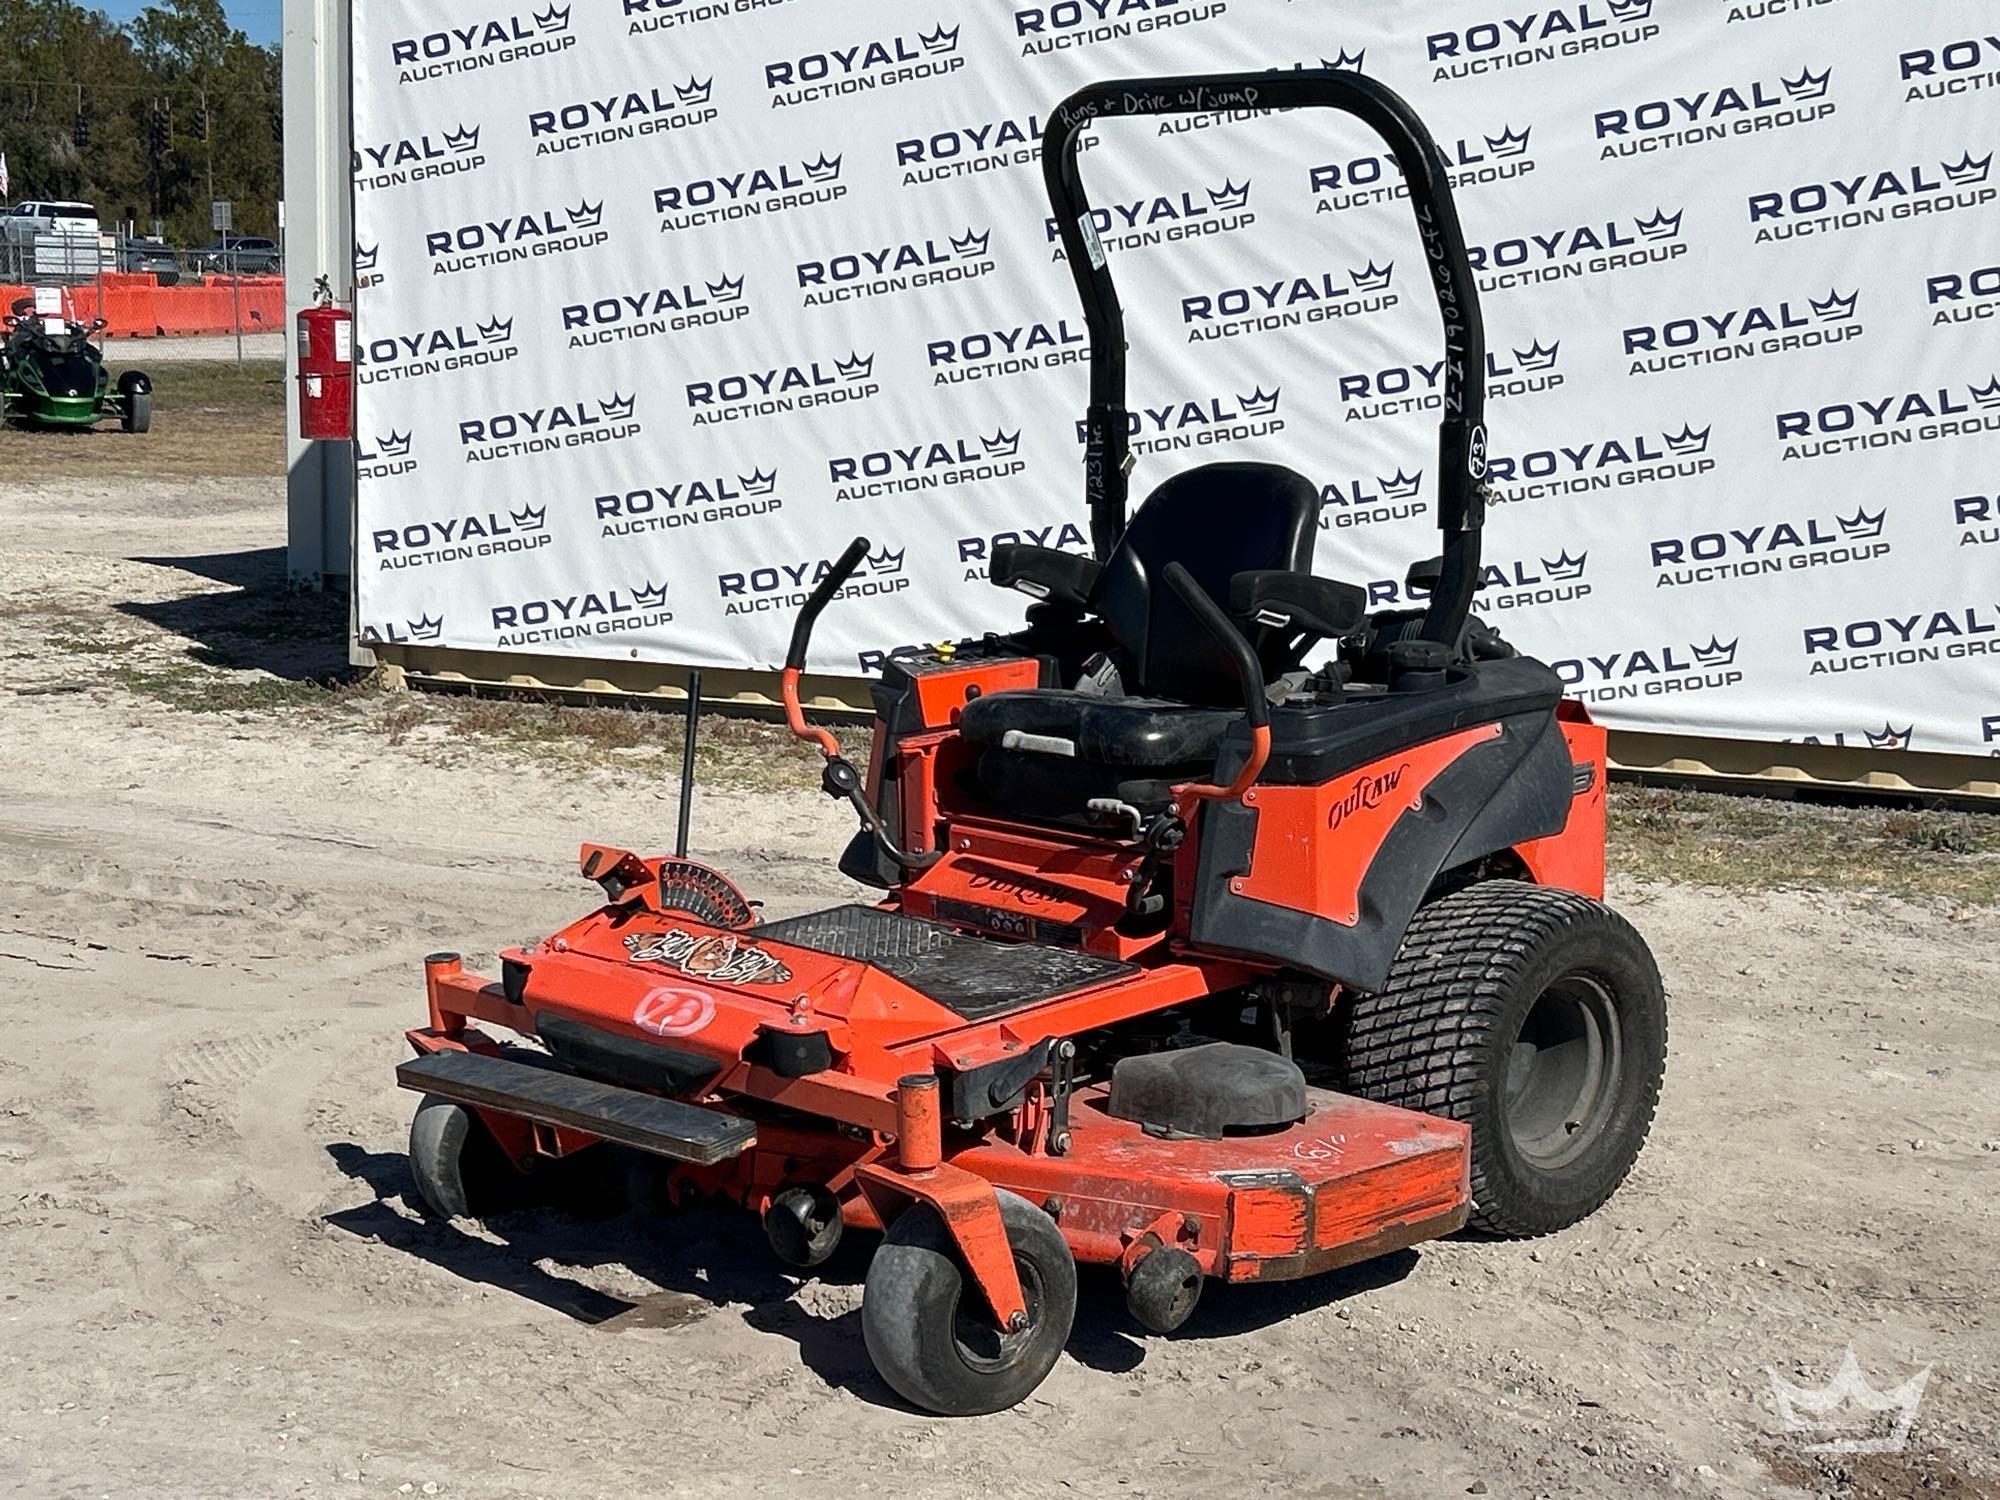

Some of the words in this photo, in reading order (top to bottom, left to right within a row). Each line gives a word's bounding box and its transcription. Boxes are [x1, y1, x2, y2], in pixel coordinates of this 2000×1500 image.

[392, 16, 534, 66] ROYAL
[629, 2, 729, 36] AUCTION
[1015, 0, 1178, 37] ROYA
[1022, 22, 1131, 57] AUCTION
[1137, 3, 1226, 32] GROUP
[1427, 4, 1606, 61] ROYAL
[399, 53, 494, 85] AUCTION
[499, 36, 576, 63] GROUP
[765, 37, 919, 89] ROYAL
[1433, 46, 1554, 82] AUCTION
[1561, 25, 1659, 56] GROUP
[772, 75, 875, 109] AUCTION
[881, 57, 964, 85] GROUP
[529, 88, 675, 137] ROYAL
[536, 125, 634, 156] AUCTION
[639, 108, 717, 135] GROUP
[1059, 101, 1099, 129] Runs
[1124, 93, 1174, 114] Drive
[1595, 82, 1781, 139] ROYAL
[1600, 124, 1726, 160] AUCTION
[1733, 103, 1835, 134] GROUP
[411, 156, 485, 181] GROUP
[654, 165, 803, 213] ROYAL
[903, 153, 1008, 186] AUCTION
[661, 202, 761, 232] AUCTION
[766, 185, 847, 212] GROUP
[1749, 166, 1941, 222] ROYAL
[1755, 208, 1884, 244] AUCTION
[1892, 188, 1997, 219] GROUP
[426, 211, 567, 257] ROYAL
[1166, 213, 1255, 241] GROUP
[434, 246, 527, 275] AUCTION
[532, 231, 608, 256] GROUP
[797, 241, 950, 288] ROYAL
[1479, 262, 1582, 292] UCTION
[1589, 244, 1687, 272] GROUP
[804, 277, 907, 307] AUCTION
[912, 261, 995, 287] GROUP
[1182, 274, 1349, 323] ROYAL
[562, 285, 707, 330] ROYAL
[569, 320, 666, 349] AUCTION
[671, 306, 749, 330] GROUP
[1188, 311, 1301, 343] AUCTION
[1307, 295, 1398, 322] GROUP
[1623, 302, 1809, 355] ROYAL
[359, 360, 440, 384] UCTION
[445, 347, 518, 370] GROUP
[927, 320, 1083, 367] ROYAL
[1629, 342, 1754, 375] AUCTION
[1761, 325, 1862, 353] GROUP
[686, 363, 835, 407] ROYAL
[934, 357, 1038, 386] AUCTION
[1339, 352, 1513, 402] ROYL
[693, 398, 793, 426] AUCTION
[798, 384, 879, 408] GROUP
[1345, 395, 1442, 422] AUCTIO
[1487, 374, 1564, 400] ROUP
[1776, 389, 1968, 440] ROYAL
[459, 403, 600, 444] ROYAL
[466, 437, 560, 463] AUCTION
[565, 424, 640, 447] GROUP
[1197, 420, 1284, 445] GROUP
[1782, 429, 1912, 461] AUCTION
[1919, 415, 2000, 440] GROU
[358, 460, 417, 480] ROUP
[829, 440, 981, 483] ROYAL
[836, 475, 937, 502] AUCTION
[943, 461, 1025, 485] GROUP
[1472, 443, 1485, 475] 73
[1487, 436, 1663, 484] ROYAL
[1617, 459, 1715, 485] GROUP
[595, 478, 739, 519] ROYAL
[602, 512, 699, 538] AUCTION
[704, 499, 782, 522] GROUP
[1336, 503, 1427, 528] GROUP
[373, 512, 512, 553] ROYAL
[380, 546, 473, 571] AUCTION
[477, 535, 551, 556] GROUP
[1651, 519, 1836, 567] ROYAL
[1656, 558, 1782, 588] AUCTION
[1789, 543, 1890, 569] GROUP
[492, 591, 632, 629] ROYAL
[1497, 584, 1591, 609] GROUP
[498, 624, 591, 647] AUCTION
[596, 612, 673, 633] GROUP
[1803, 608, 1995, 654] ROYAL
[1551, 647, 1690, 684] OYAL
[1645, 671, 1742, 695] GROUP
[1810, 646, 1939, 675] AUCTION
